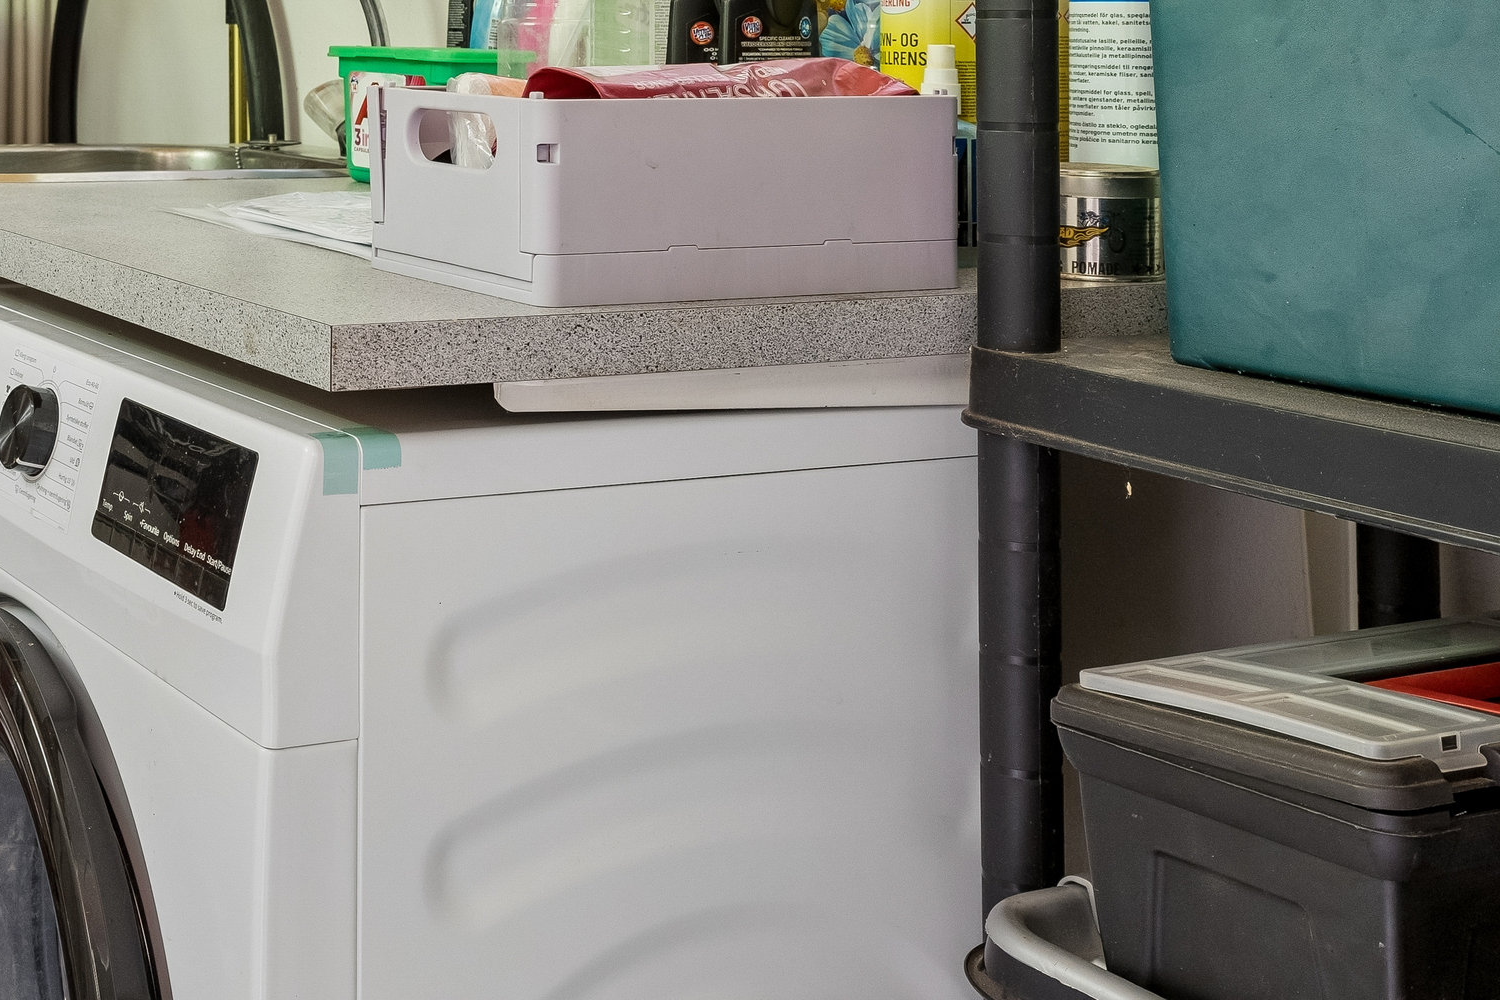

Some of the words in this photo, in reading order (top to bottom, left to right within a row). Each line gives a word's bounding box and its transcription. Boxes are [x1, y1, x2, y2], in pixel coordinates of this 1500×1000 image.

[900, 33, 918, 47] OG
[354, 127, 361, 146] 3
[1072, 260, 1119, 276] POMADE
[123, 510, 133, 522] Spin
[163, 531, 180, 548] Options
[183, 542, 197, 558] Delay
[196, 548, 206, 561] End
